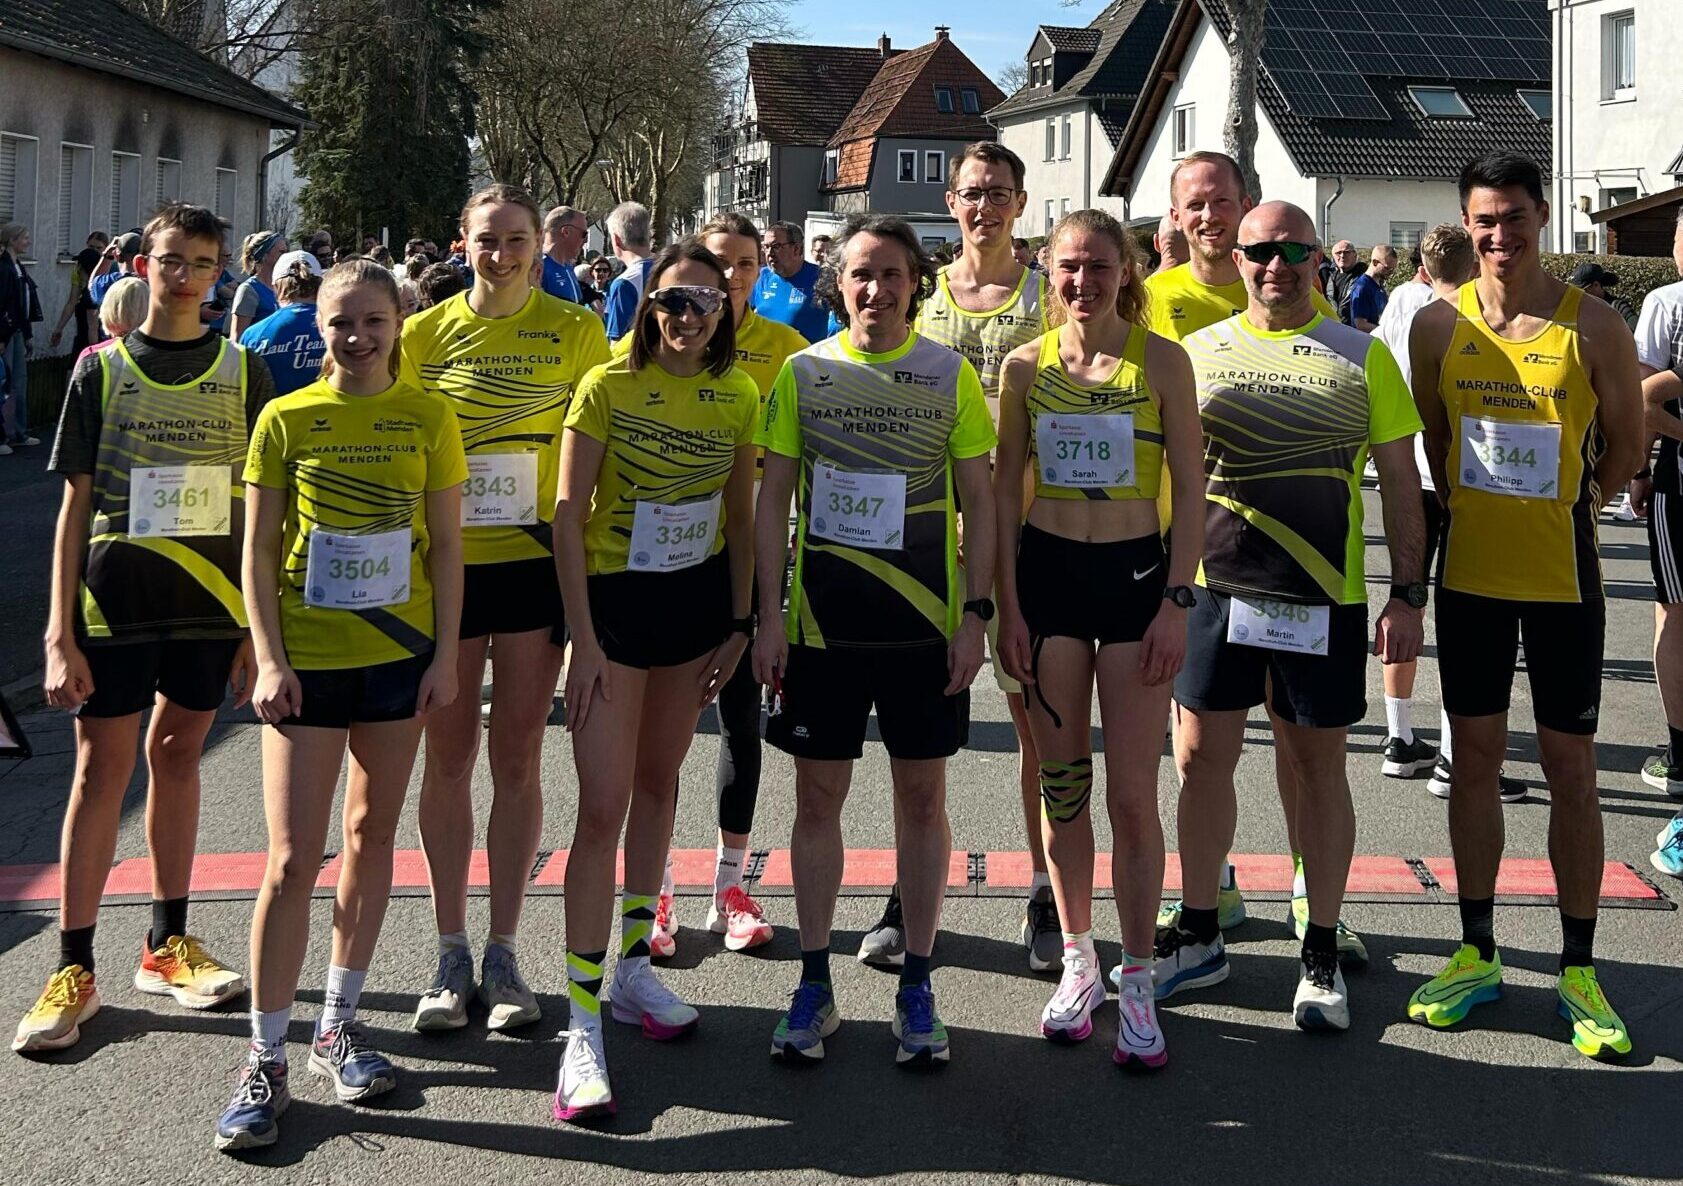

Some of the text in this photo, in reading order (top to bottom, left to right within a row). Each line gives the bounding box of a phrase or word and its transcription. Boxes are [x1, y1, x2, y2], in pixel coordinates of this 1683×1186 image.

[518, 330, 557, 338] Franke
[444, 355, 562, 369] MARATHON-CLUB
[473, 367, 533, 377] MENDEN
[1206, 371, 1338, 388] MARATHON-CLUB
[1234, 383, 1302, 396] MENDEN
[1456, 380, 1567, 400] MARATHON-CLUB
[1482, 395, 1536, 410] MENDEN
[811, 407, 943, 420] MARATHON-CLUB
[842, 422, 910, 433] MENDEN
[145, 432, 207, 442] MENDEN
[312, 445, 417, 454] MARATHON-CLUB
[660, 443, 716, 455] MENDEN
[1056, 440, 1110, 460] 3718
[1480, 442, 1537, 468] 3344
[338, 454, 392, 464] MENDEN
[1072, 470, 1097, 478] Sarah
[1490, 475, 1523, 486] Philipp
[153, 487, 209, 509] 3461
[828, 492, 884, 518] 3347
[173, 517, 194, 525] Tom
[656, 521, 708, 545] 3348
[838, 523, 871, 536] Damian
[329, 556, 391, 580] 3504
[352, 590, 367, 598] Lia
[1266, 629, 1295, 640] Martin
